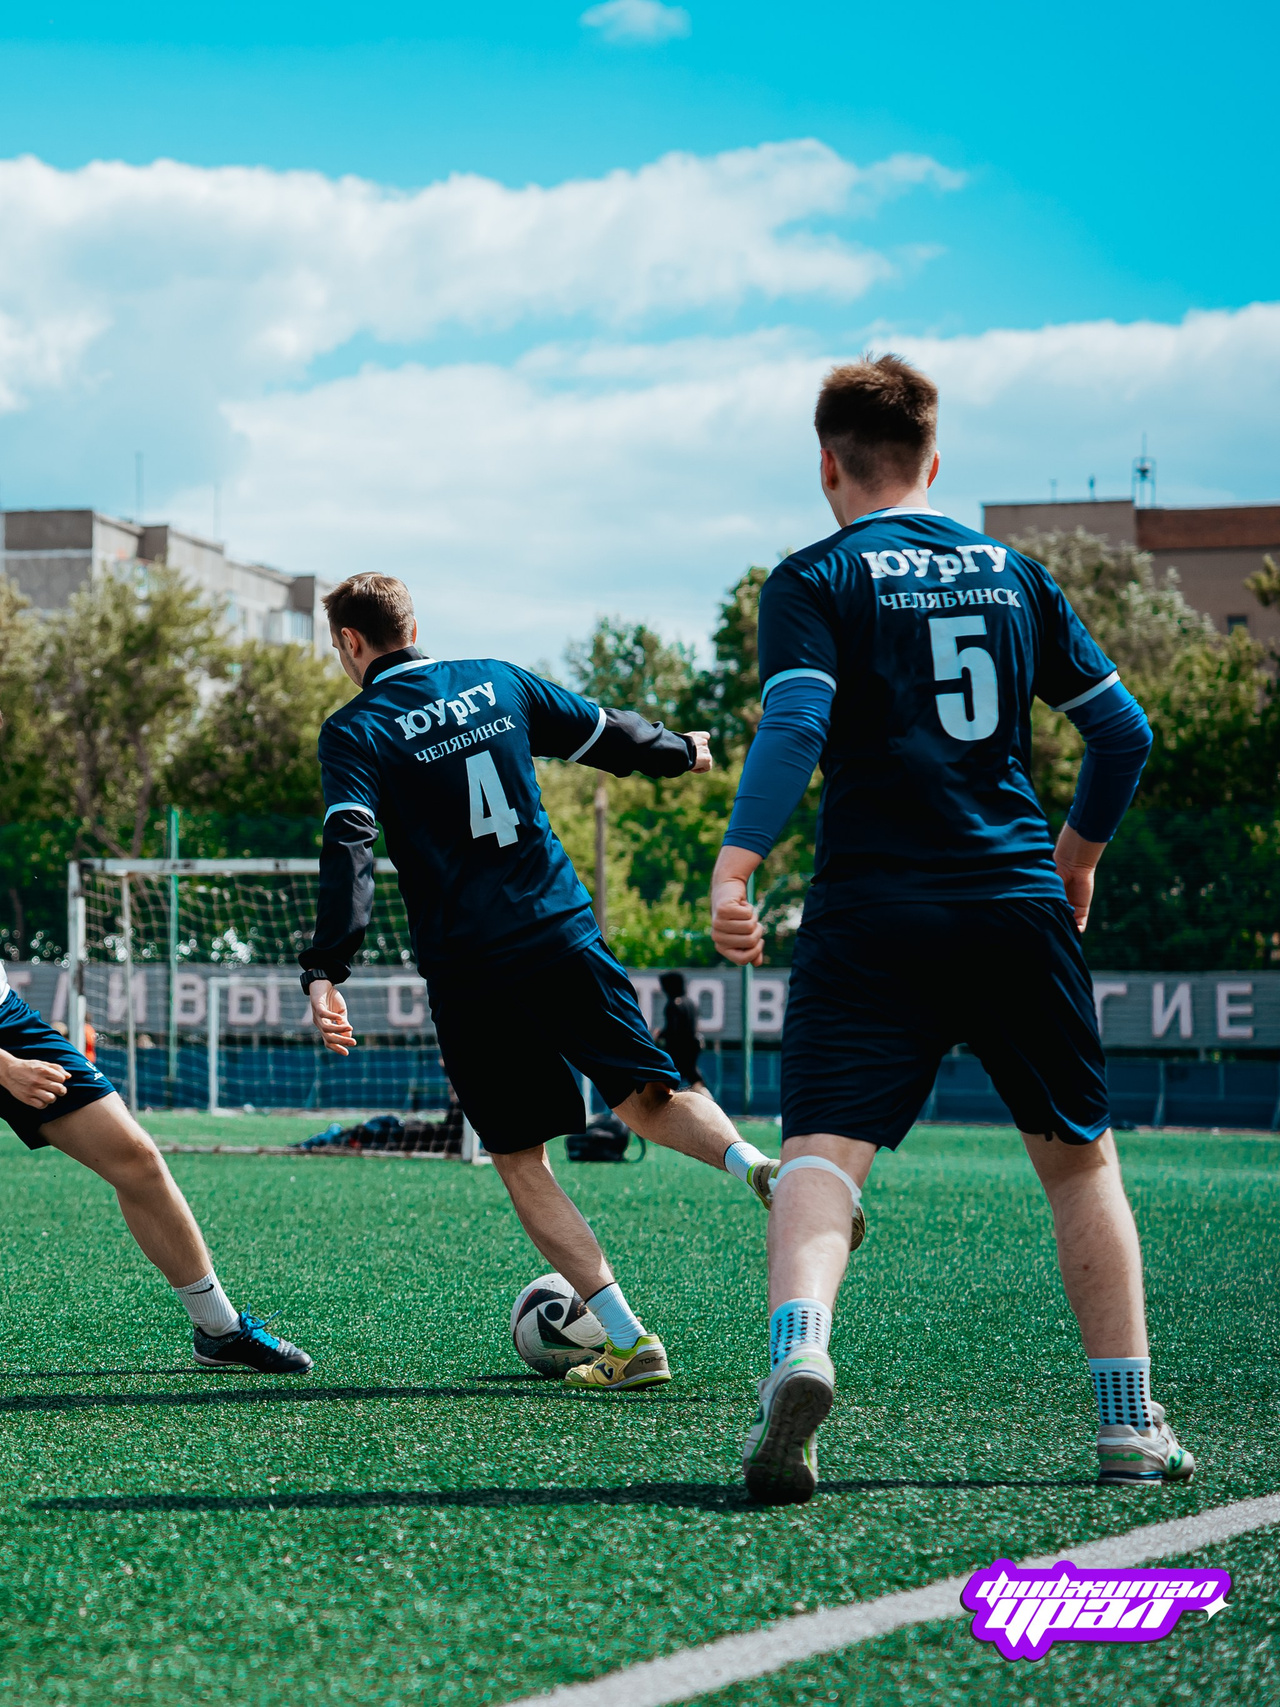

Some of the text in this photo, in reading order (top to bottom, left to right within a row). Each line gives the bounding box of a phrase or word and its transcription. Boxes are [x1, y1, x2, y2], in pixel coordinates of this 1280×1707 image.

[861, 544, 1008, 583] ЮУрГУ
[878, 588, 1021, 609] ЧЕЛЯБИНСК
[928, 614, 999, 741] 5
[395, 681, 497, 740] ЮУрГУ
[414, 715, 516, 764] ЧЕЛЯБИНСК
[465, 750, 520, 847] 4
